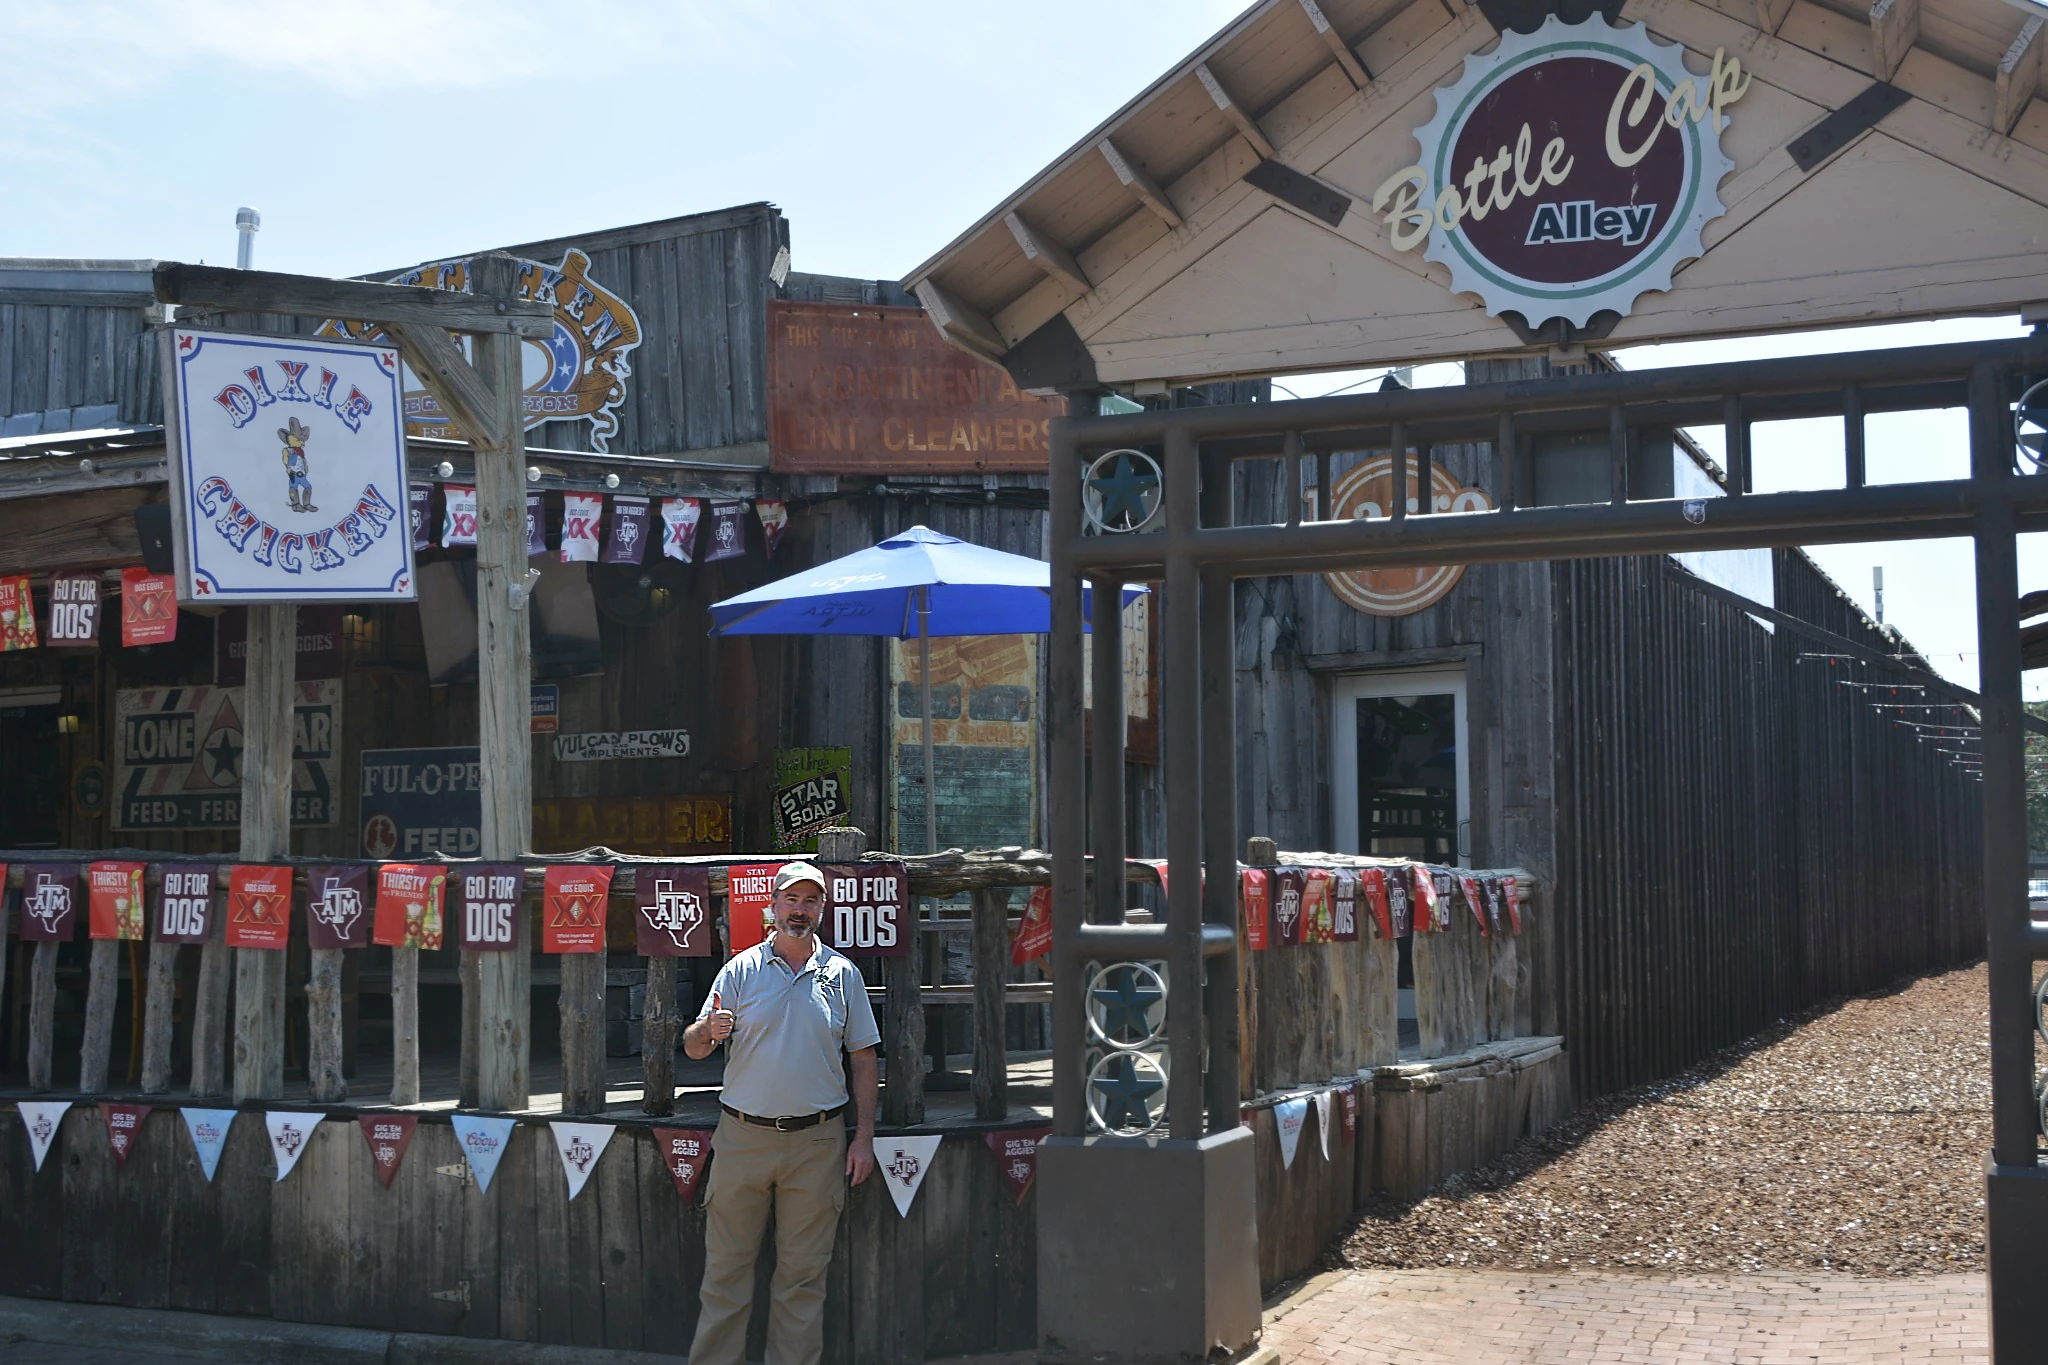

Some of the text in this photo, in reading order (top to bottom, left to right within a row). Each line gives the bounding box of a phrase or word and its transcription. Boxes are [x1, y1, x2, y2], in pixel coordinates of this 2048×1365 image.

[1373, 46, 1751, 251] Bottle Cap
[1525, 200, 1657, 246] Alley
[214, 360, 372, 433] DIXIE
[196, 476, 396, 574] CHICKEN
[54, 580, 96, 600] GO FOR
[127, 590, 172, 623] XX
[52, 604, 94, 638] DOS
[126, 711, 330, 759] LONE AR
[556, 731, 687, 760] VULCAN PLOWS
[900, 723, 949, 743] OTER
[363, 763, 480, 797] FUL-O-PE
[781, 779, 838, 815] STAR
[130, 801, 178, 823] FEED
[790, 799, 837, 827] SOAP
[404, 828, 480, 853] FEED
[92, 871, 128, 886] THIRSTY
[165, 874, 208, 895] GO FOR
[382, 872, 427, 891] THIRSTY
[746, 868, 767, 876] STAY
[245, 884, 277, 893] DOS EQUIS
[391, 890, 425, 899] FRIENDS
[466, 876, 515, 899] GO FOR
[574, 884, 594, 892] EQUIS
[732, 876, 775, 894] THIRST
[833, 877, 898, 902] GO FOR
[163, 899, 206, 935] DOS
[233, 893, 286, 926] XX
[550, 894, 603, 927] XX
[466, 903, 511, 942] DOS
[834, 905, 897, 948] DOS
[467, 1132, 498, 1146] Coors
[672, 1139, 686, 1147] GIG
[672, 1147, 699, 1156] AGGIES
[1005, 1140, 1019, 1149] GIG
[1005, 1147, 1036, 1156] AGGIES
